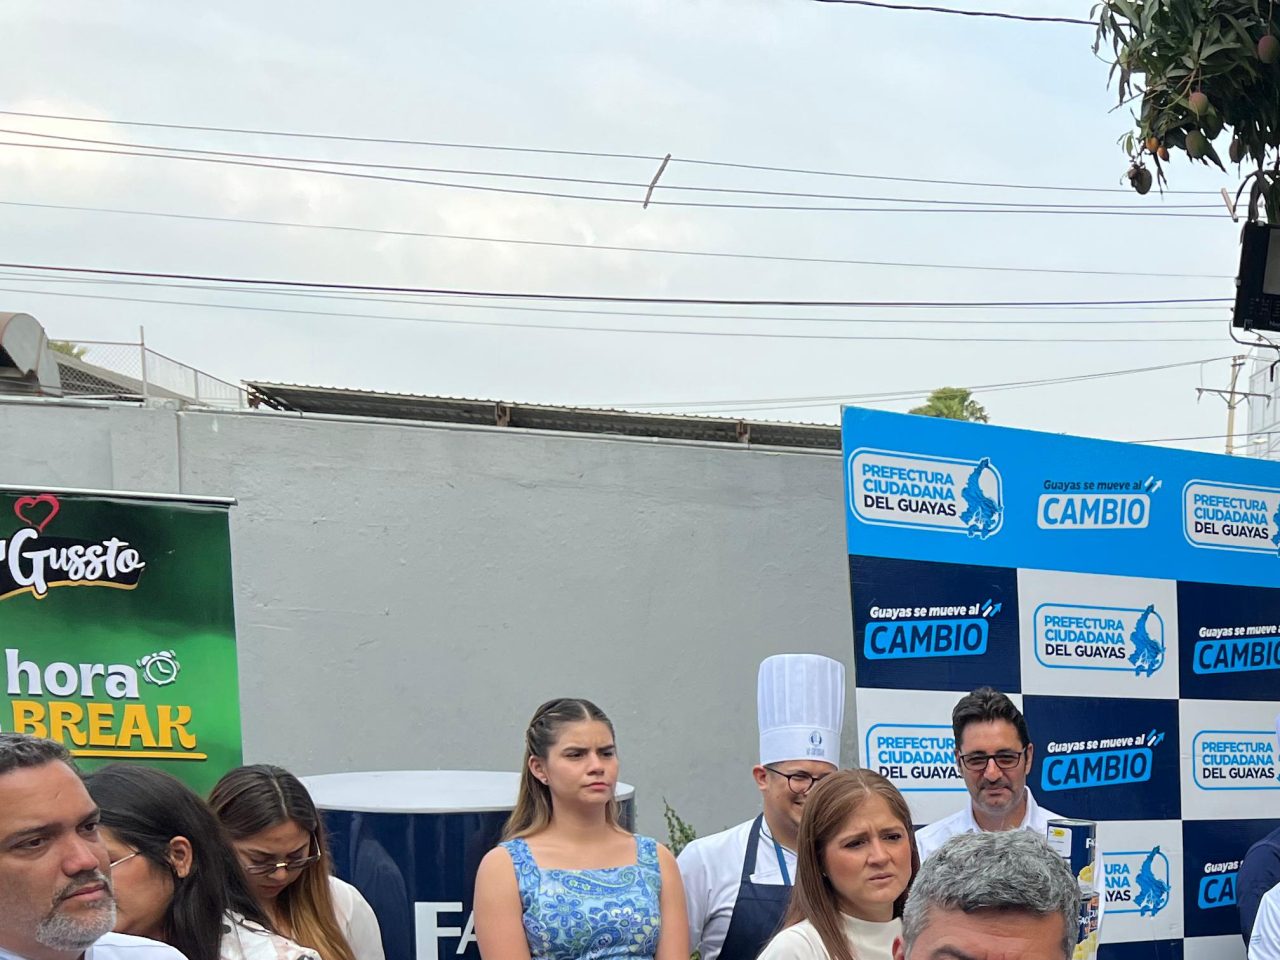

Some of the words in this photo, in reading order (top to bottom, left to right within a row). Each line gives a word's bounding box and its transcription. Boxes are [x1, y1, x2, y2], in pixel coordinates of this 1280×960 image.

[862, 463, 955, 486] PREFECTURA
[863, 479, 956, 501] CIUDADANA
[1044, 480, 1081, 491] Guayas
[1084, 482, 1095, 490] se
[1097, 481, 1130, 490] mueve
[1133, 480, 1142, 490] al
[864, 494, 894, 510] DEL
[898, 498, 957, 516] GUAYAS
[1043, 497, 1145, 525] CAMBIO
[1194, 493, 1268, 512] PREFECTURA
[1194, 507, 1269, 526] CIUDADANA
[1194, 521, 1220, 535] DEL
[1222, 524, 1269, 540] GUAYAS
[8, 528, 146, 594] Gussto
[870, 606, 912, 620] Guayas
[914, 606, 927, 617] se
[929, 606, 967, 617] mueve
[968, 603, 980, 615] al
[1044, 615, 1125, 631] PREFECTURA
[1199, 626, 1233, 638] Guayas
[1234, 627, 1245, 636] se
[1246, 625, 1277, 635] mueve
[870, 623, 983, 655] CAMBIO
[1045, 629, 1125, 645] CIUDADANA
[1045, 644, 1072, 656] DEL
[1075, 645, 1126, 659] GUAYAS
[6, 648, 139, 698] hora
[12, 699, 197, 750] BREAK
[877, 737, 956, 749] PREFECTUR
[1047, 741, 1085, 753] Guayas
[1086, 740, 1098, 750] se
[1100, 738, 1133, 748] mueve
[1135, 734, 1146, 746] al
[1202, 742, 1273, 753] PREFECTURA
[878, 751, 956, 764] CIUDADAN
[1202, 754, 1274, 766] CIUDADANA
[879, 766, 908, 779] DEL
[1047, 752, 1147, 786] CAMBIO
[1203, 767, 1226, 779] DEL
[1229, 767, 1275, 779] GUAYAS
[1204, 861, 1238, 874] Guayas
